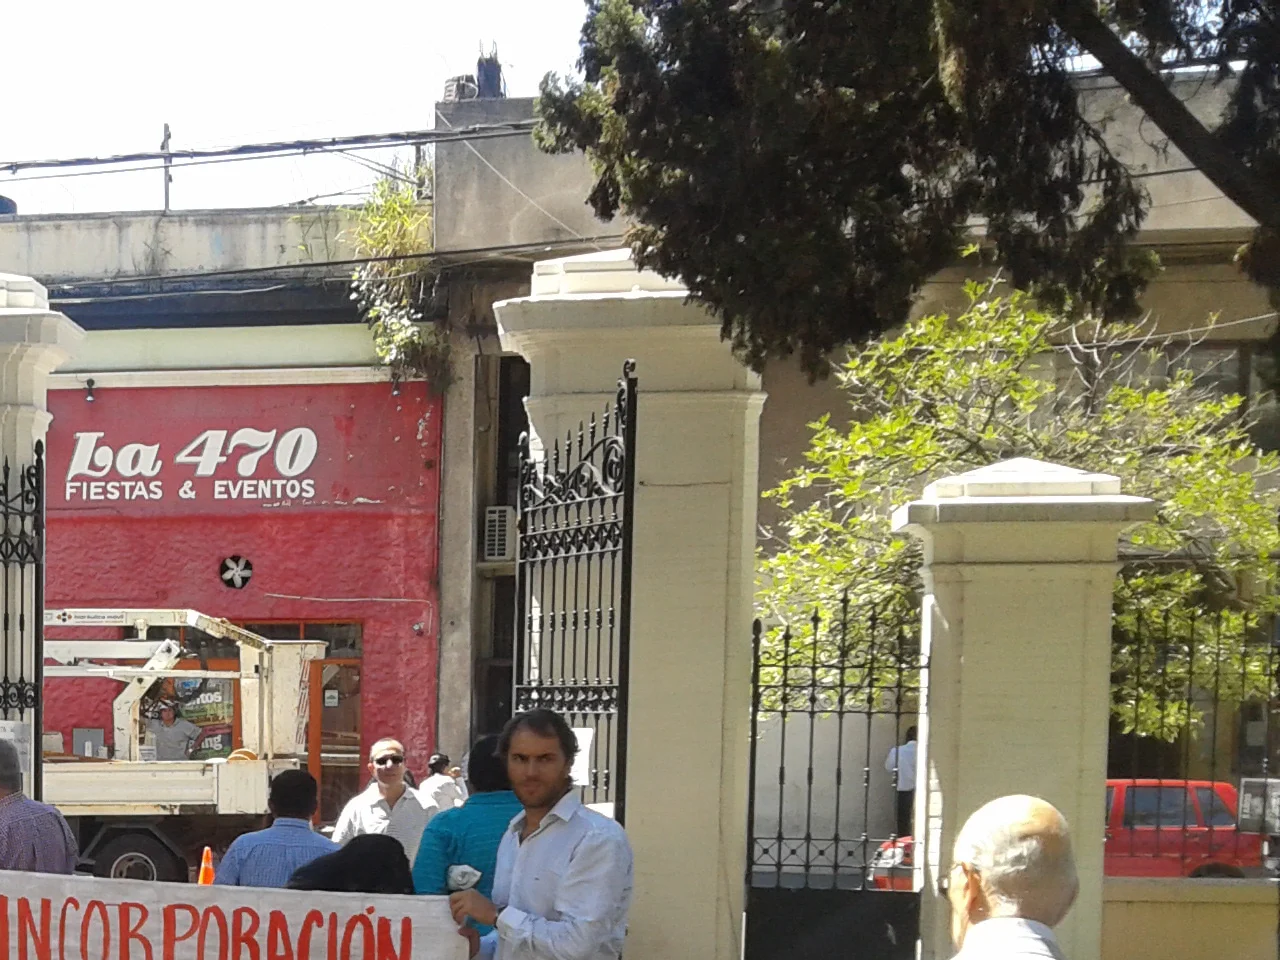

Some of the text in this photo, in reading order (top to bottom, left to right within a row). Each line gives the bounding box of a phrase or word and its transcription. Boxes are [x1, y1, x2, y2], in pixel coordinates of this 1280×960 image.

[66, 427, 318, 481] La 470
[65, 479, 315, 501] FIESTAS & EVENTOS
